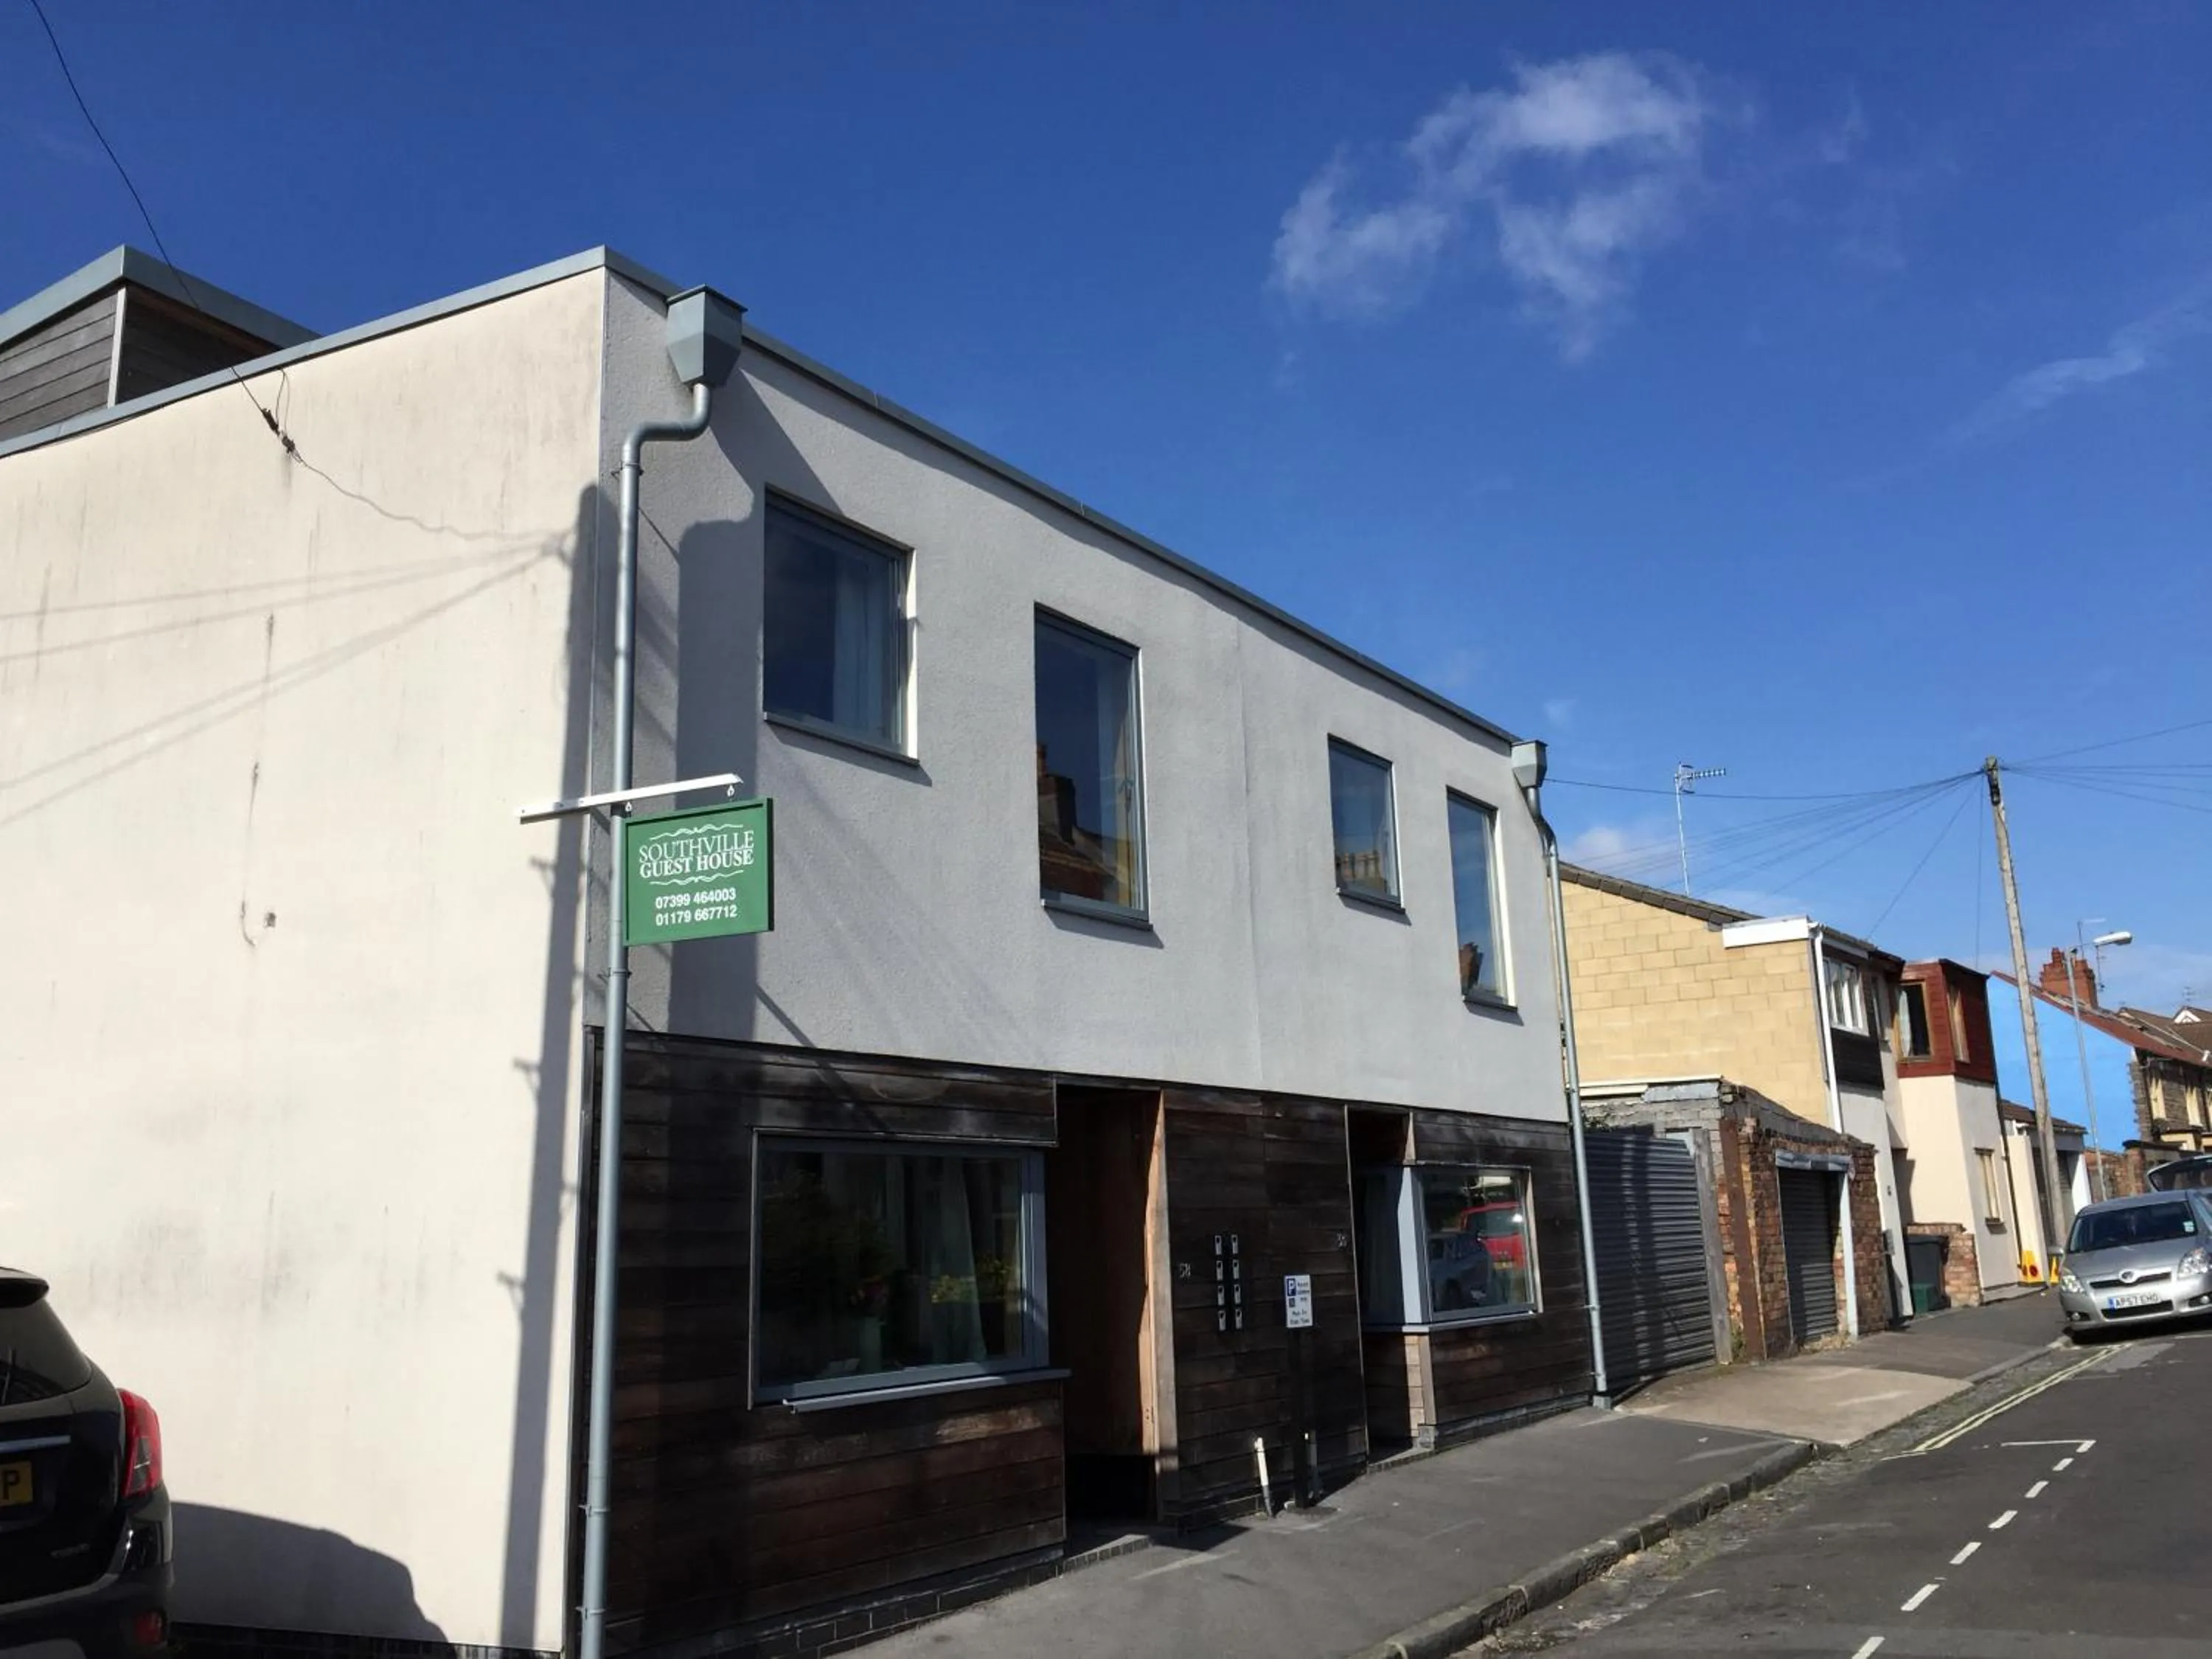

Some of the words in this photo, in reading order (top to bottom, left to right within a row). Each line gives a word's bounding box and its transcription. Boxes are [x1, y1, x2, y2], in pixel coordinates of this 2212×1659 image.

[639, 830, 754, 863] SOUTHVILLE
[639, 858, 693, 878] GUEST
[696, 849, 754, 872] HOUSE
[655, 893, 690, 908] 07399
[693, 887, 736, 905] 464003
[655, 910, 691, 926] 01179
[694, 905, 737, 921] 667712
